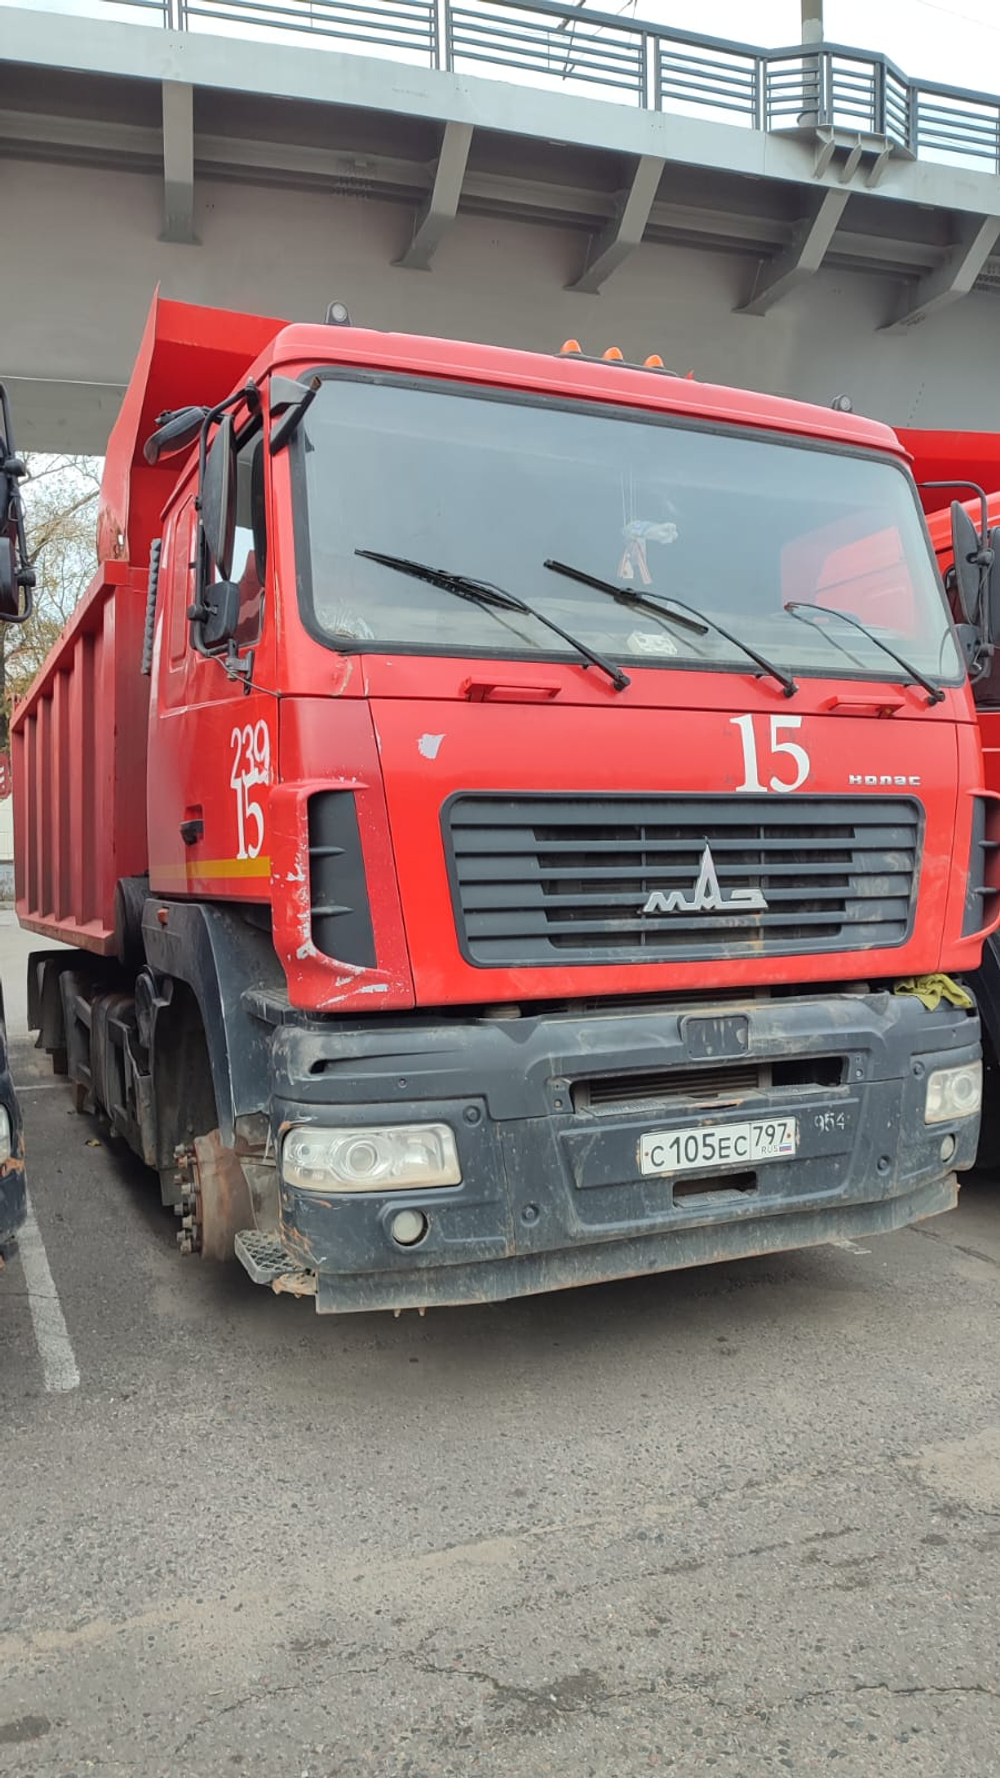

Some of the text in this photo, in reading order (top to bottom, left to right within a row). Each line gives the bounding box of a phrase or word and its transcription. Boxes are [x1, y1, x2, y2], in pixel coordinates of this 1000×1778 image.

[230, 718, 271, 785] 239
[729, 713, 811, 793] 15
[230, 768, 265, 860] 15
[753, 1122, 788, 1148] 797
[761, 1144, 779, 1154] RUS
